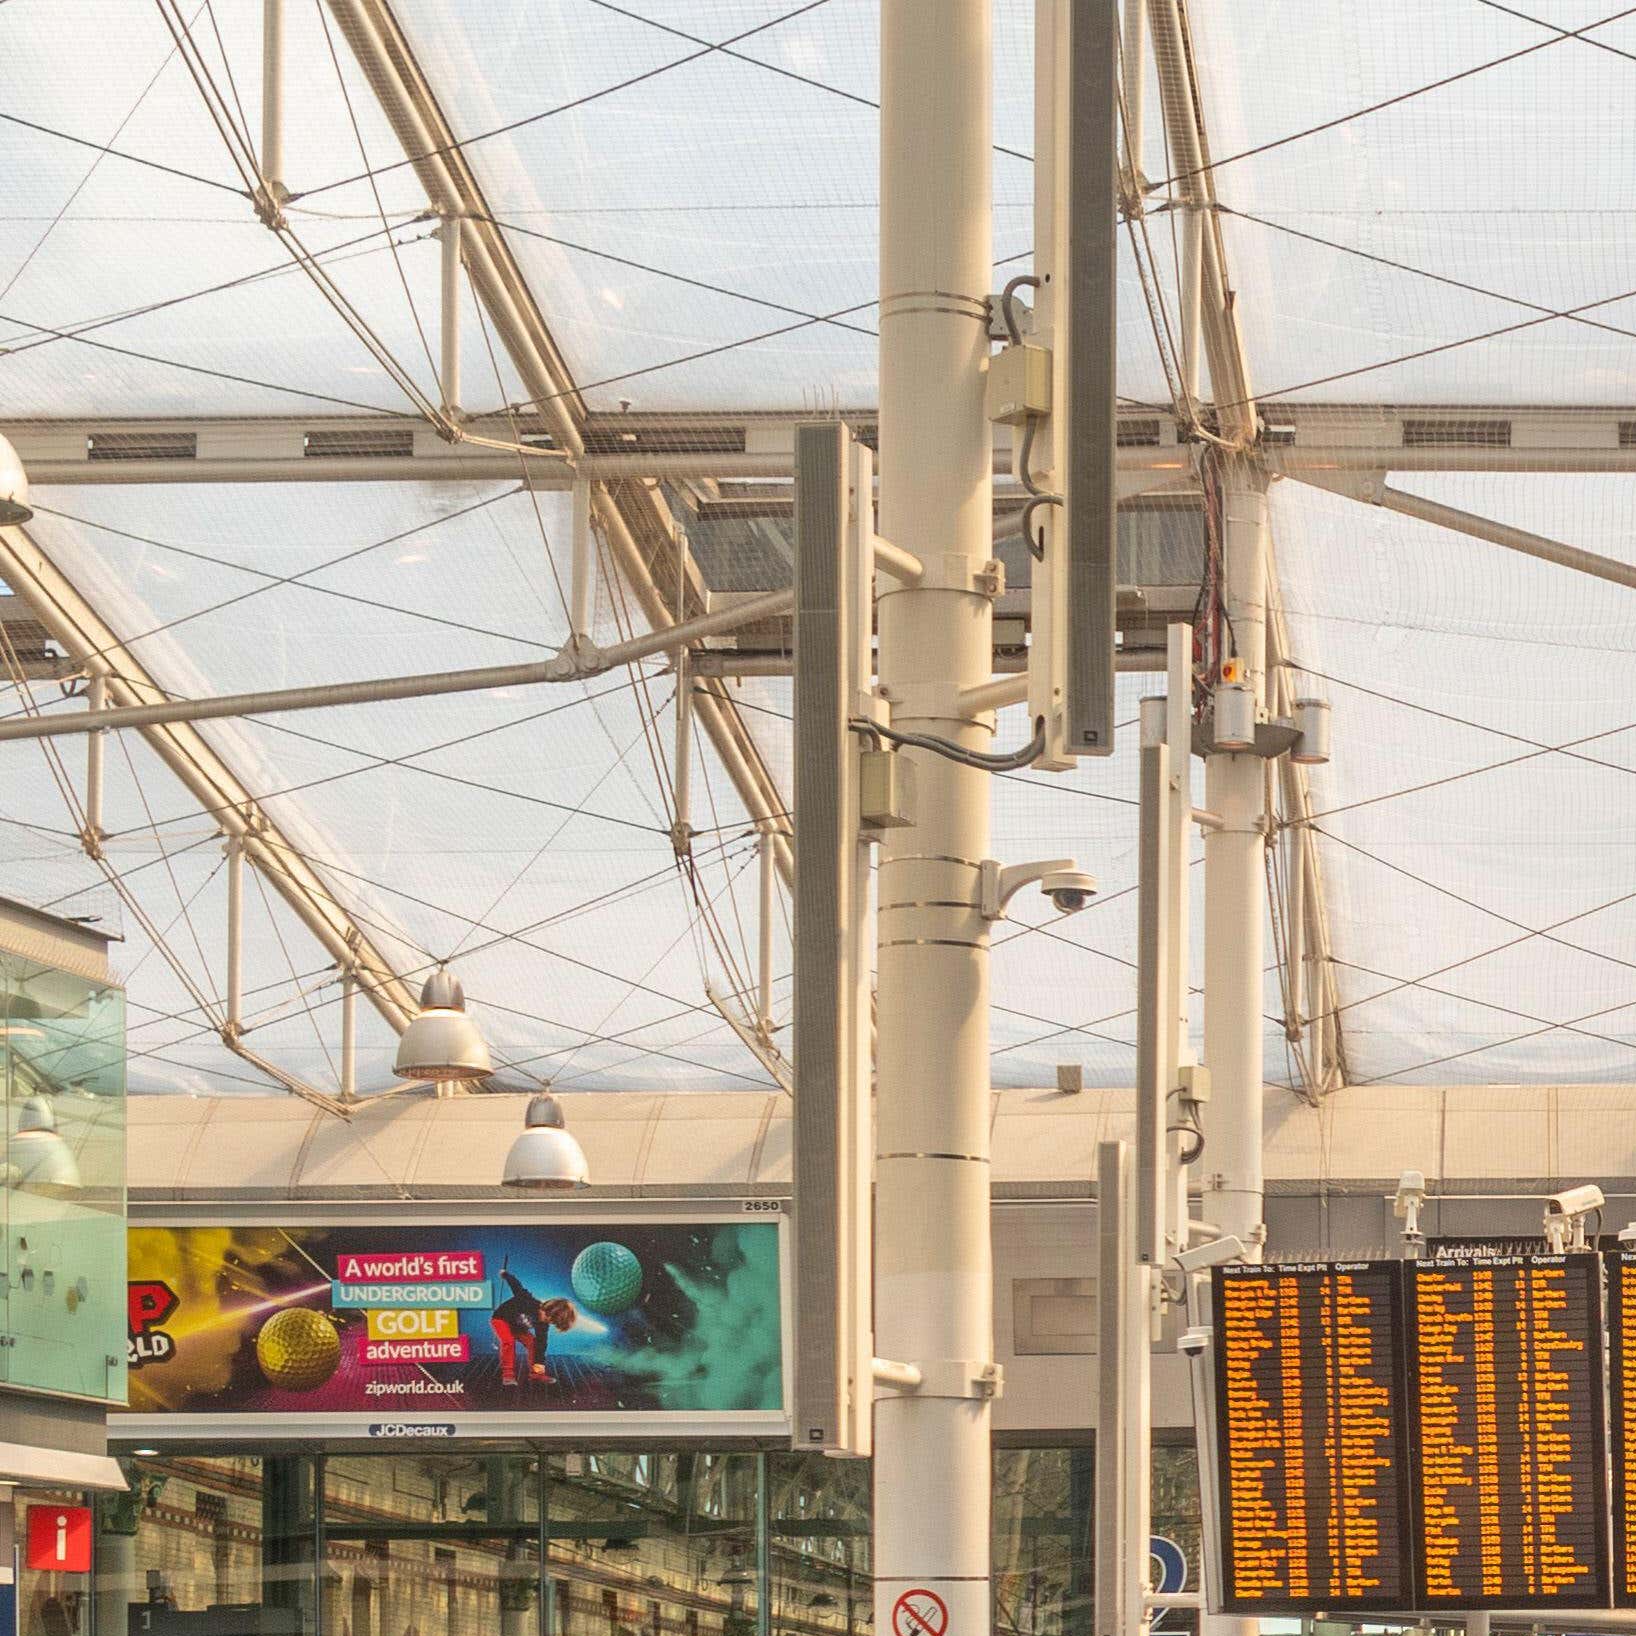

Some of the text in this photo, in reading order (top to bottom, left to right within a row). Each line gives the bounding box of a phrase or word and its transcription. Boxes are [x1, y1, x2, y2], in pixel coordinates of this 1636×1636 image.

[745, 1201, 779, 1211] 2650
[345, 1255, 477, 1277] A world's first
[340, 1286, 483, 1302] UNDERGROUND
[376, 1310, 450, 1334] GOLF
[366, 1341, 462, 1359] adventure
[365, 1380, 464, 1396] zipworld.co.uk
[376, 1424, 449, 1437] JCDecaux
